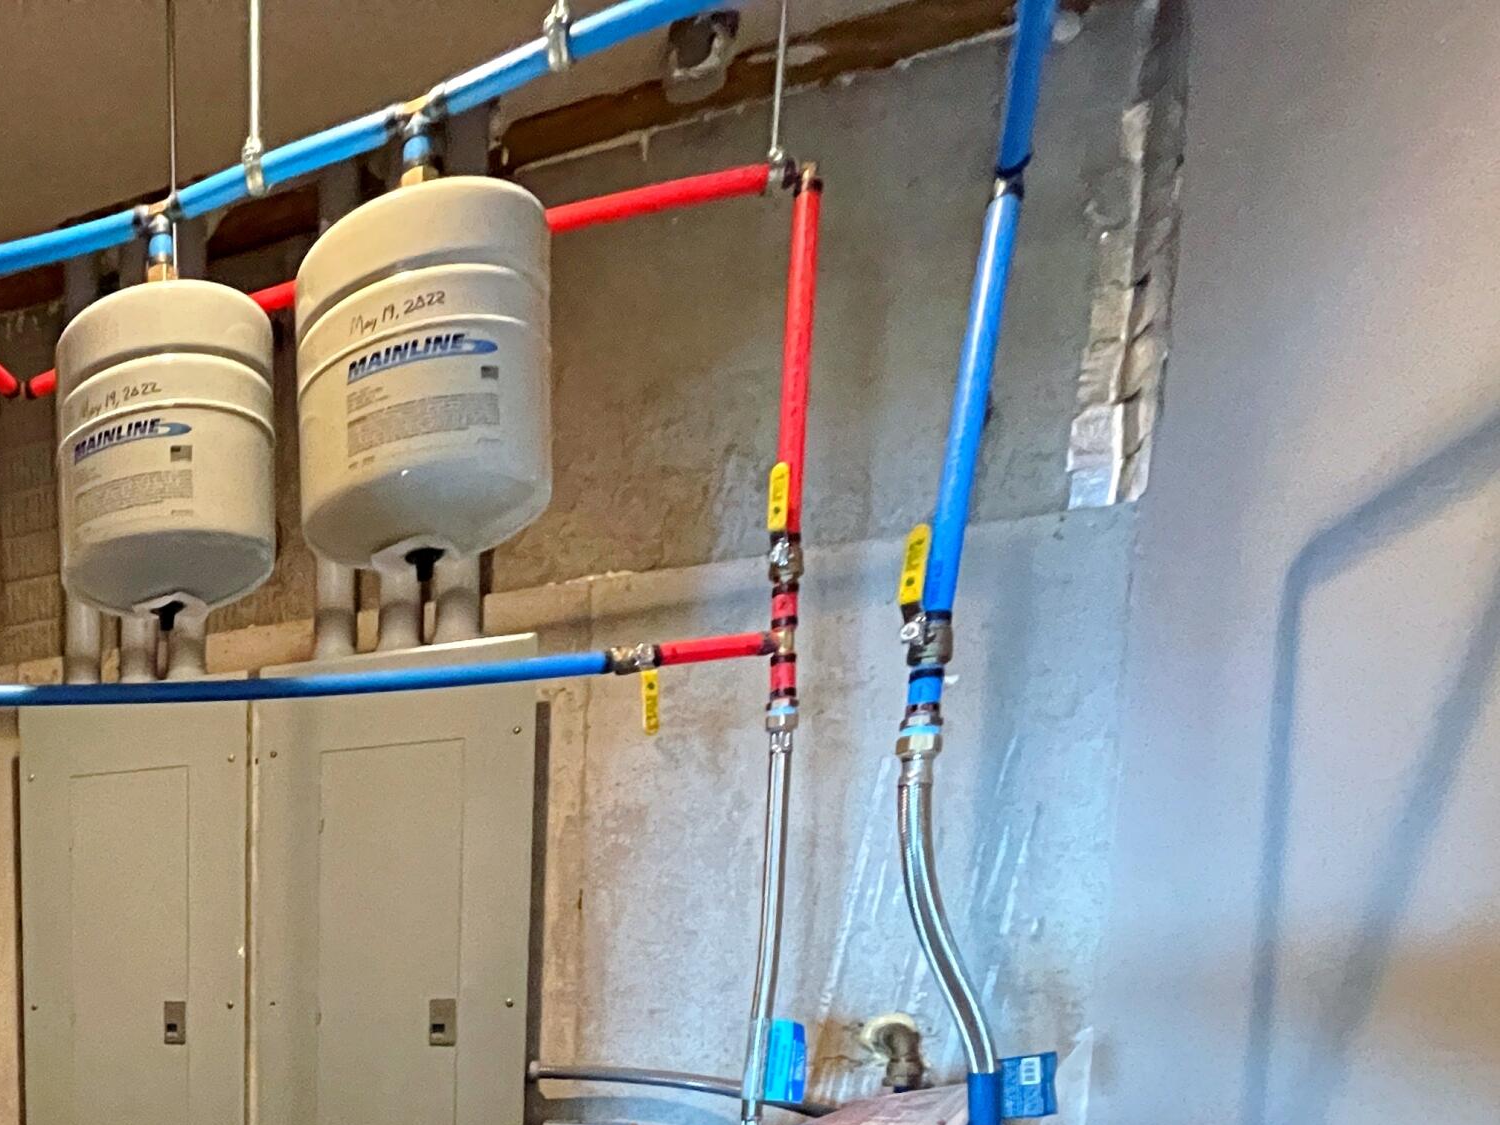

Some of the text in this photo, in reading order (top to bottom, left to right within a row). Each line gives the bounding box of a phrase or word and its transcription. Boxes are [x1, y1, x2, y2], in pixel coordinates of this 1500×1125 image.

[350, 313, 377, 336] May
[404, 291, 446, 316] 2022
[348, 333, 467, 380] MAINLINE
[122, 381, 163, 402] 2022
[74, 418, 162, 459] MAINLINE
